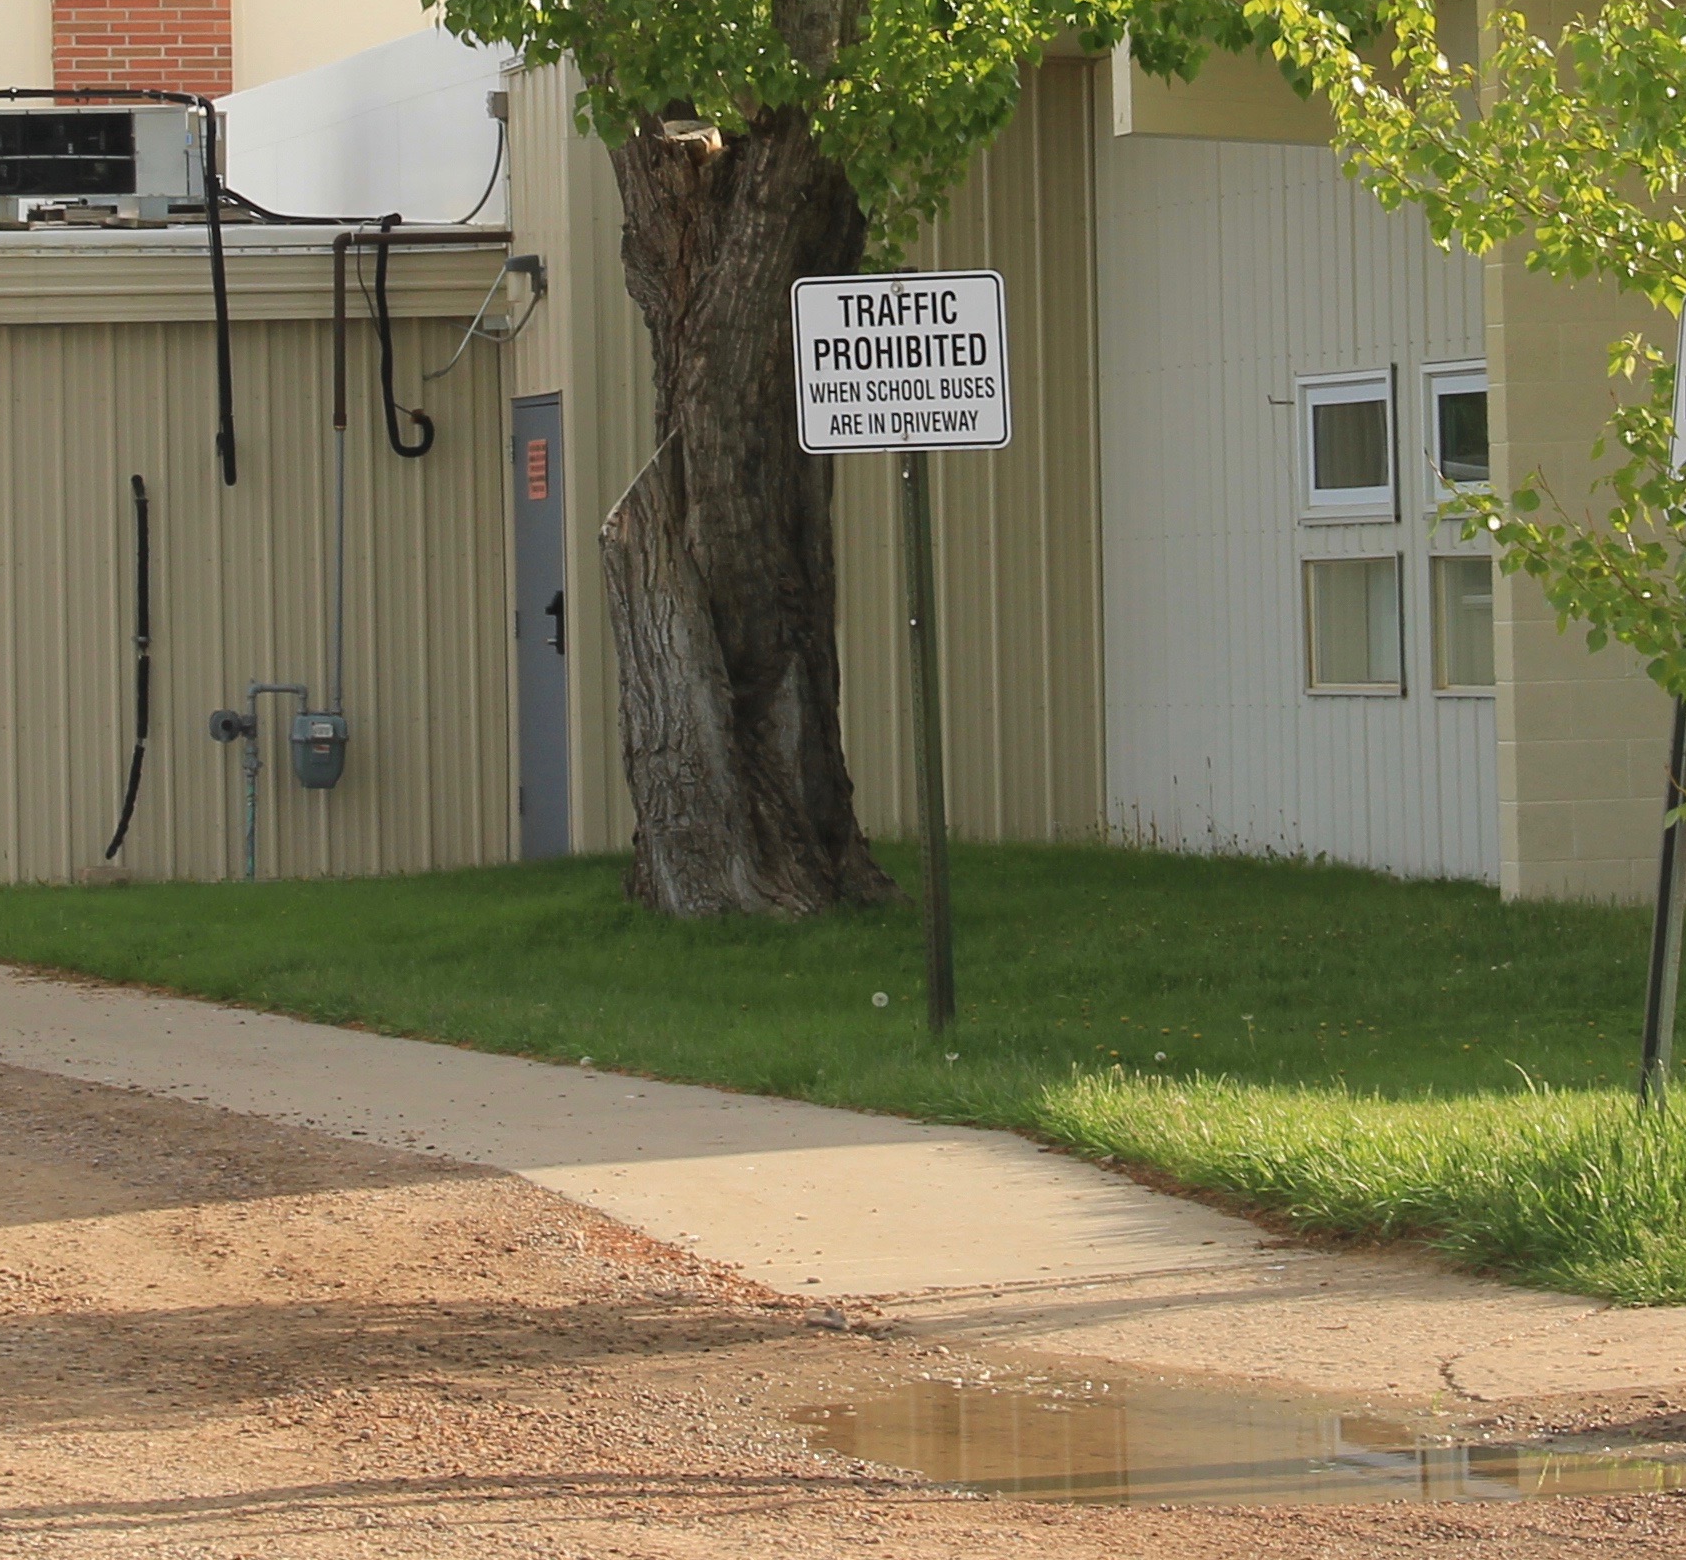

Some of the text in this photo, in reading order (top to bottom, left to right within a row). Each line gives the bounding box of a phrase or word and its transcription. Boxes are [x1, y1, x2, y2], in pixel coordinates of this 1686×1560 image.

[837, 290, 958, 328] TRAFFIC
[813, 333, 987, 371] PROHIBITED
[809, 376, 995, 404] WHEN SCHOOL BUSES
[830, 409, 979, 436] ARE IN DRIVEWAY
